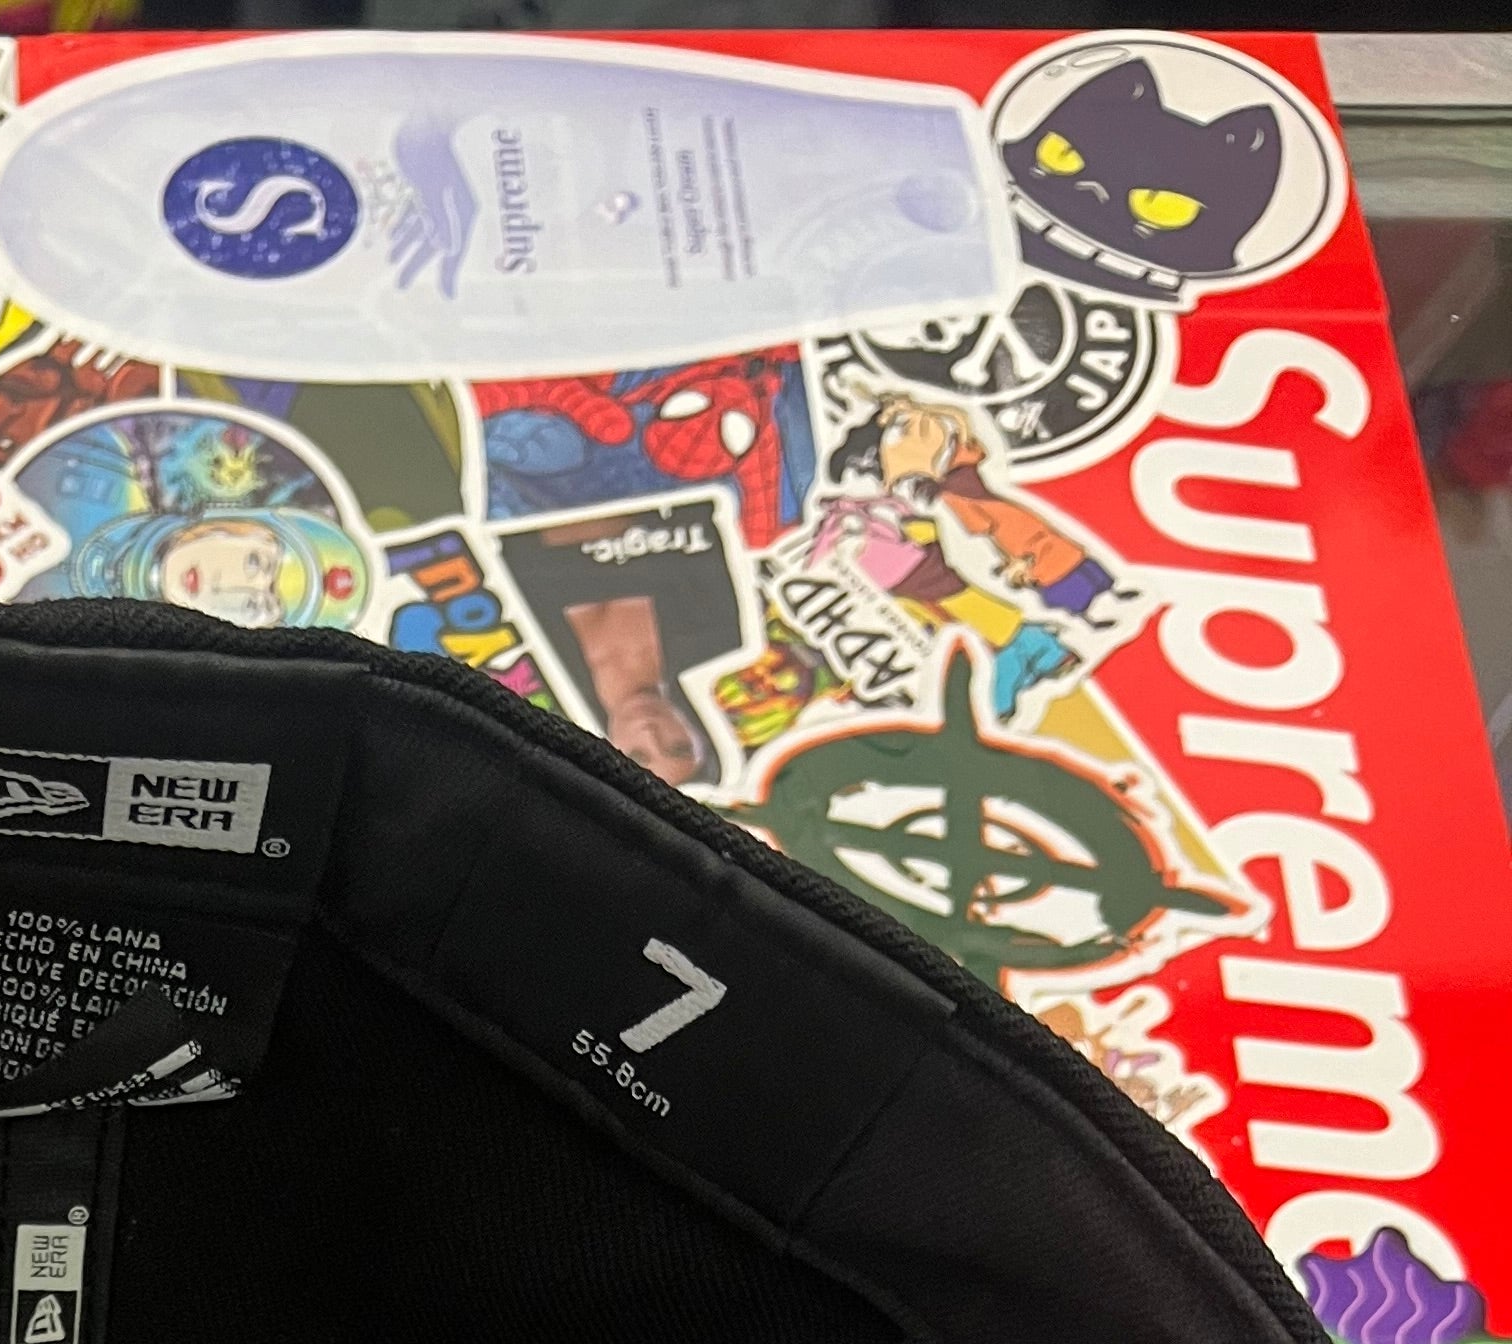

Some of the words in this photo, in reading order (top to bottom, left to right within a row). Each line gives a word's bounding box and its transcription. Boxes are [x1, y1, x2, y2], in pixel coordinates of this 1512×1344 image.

[492, 129, 540, 274] Supreme
[1066, 310, 1133, 412] JAP
[782, 580, 915, 690] ADHD
[132, 774, 237, 801] NEW
[128, 803, 234, 832] ERA
[8, 910, 84, 937] 100%
[89, 924, 161, 950] LANA
[68, 942, 100, 964] EN
[112, 951, 187, 980] CHINA
[619, 937, 727, 1053] 7
[572, 1029, 670, 1116] 55.8cm
[30, 1235, 50, 1278] NEW
[49, 1235, 70, 1279] ERA
